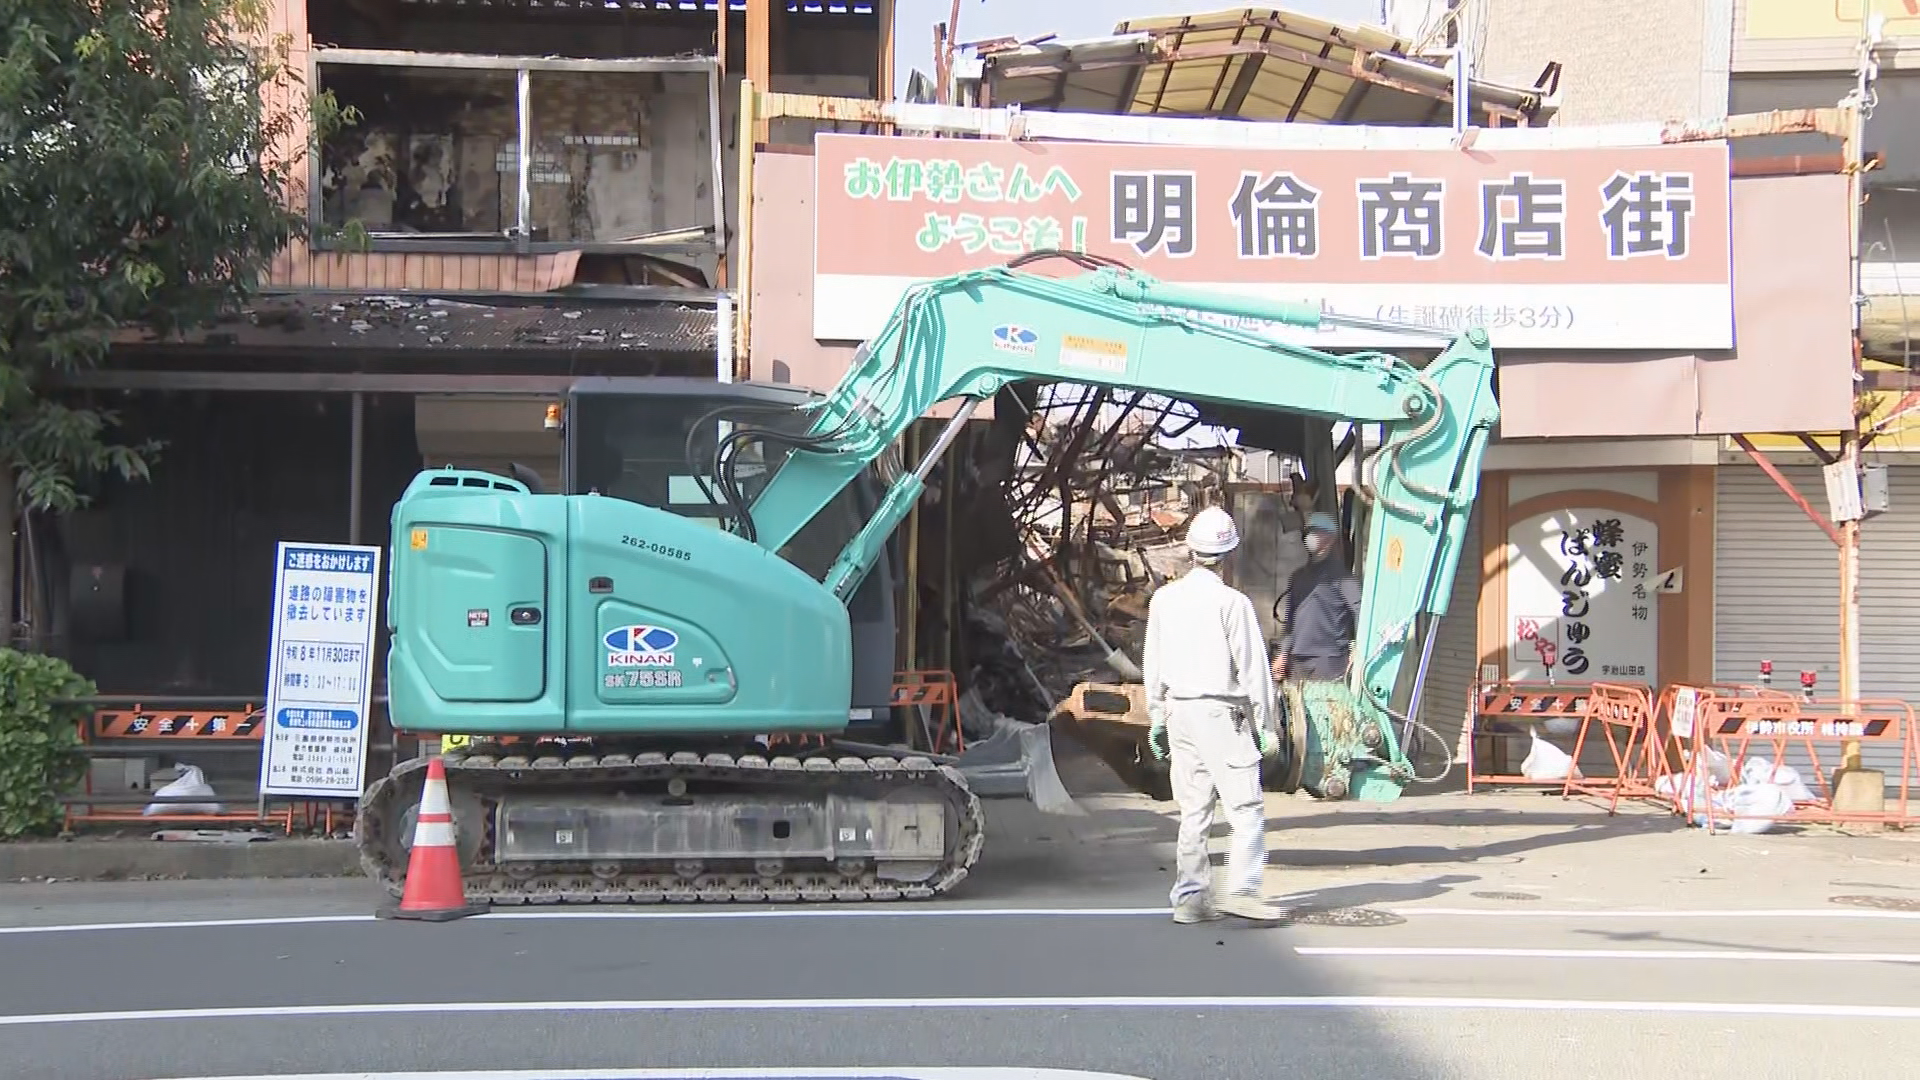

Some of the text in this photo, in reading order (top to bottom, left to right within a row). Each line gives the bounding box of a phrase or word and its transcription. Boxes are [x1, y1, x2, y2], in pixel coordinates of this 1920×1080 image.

[846, 158, 1081, 201] お伊勢さんへ
[1111, 171, 1695, 262] 明倫商店街
[621, 535, 691, 560] 262-00585
[1592, 519, 1624, 579] 蜂蜜
[1632, 542, 1648, 620] 伊勢名物
[610, 655, 672, 664] KINAN
[1602, 665, 1645, 675] 宇治山田店
